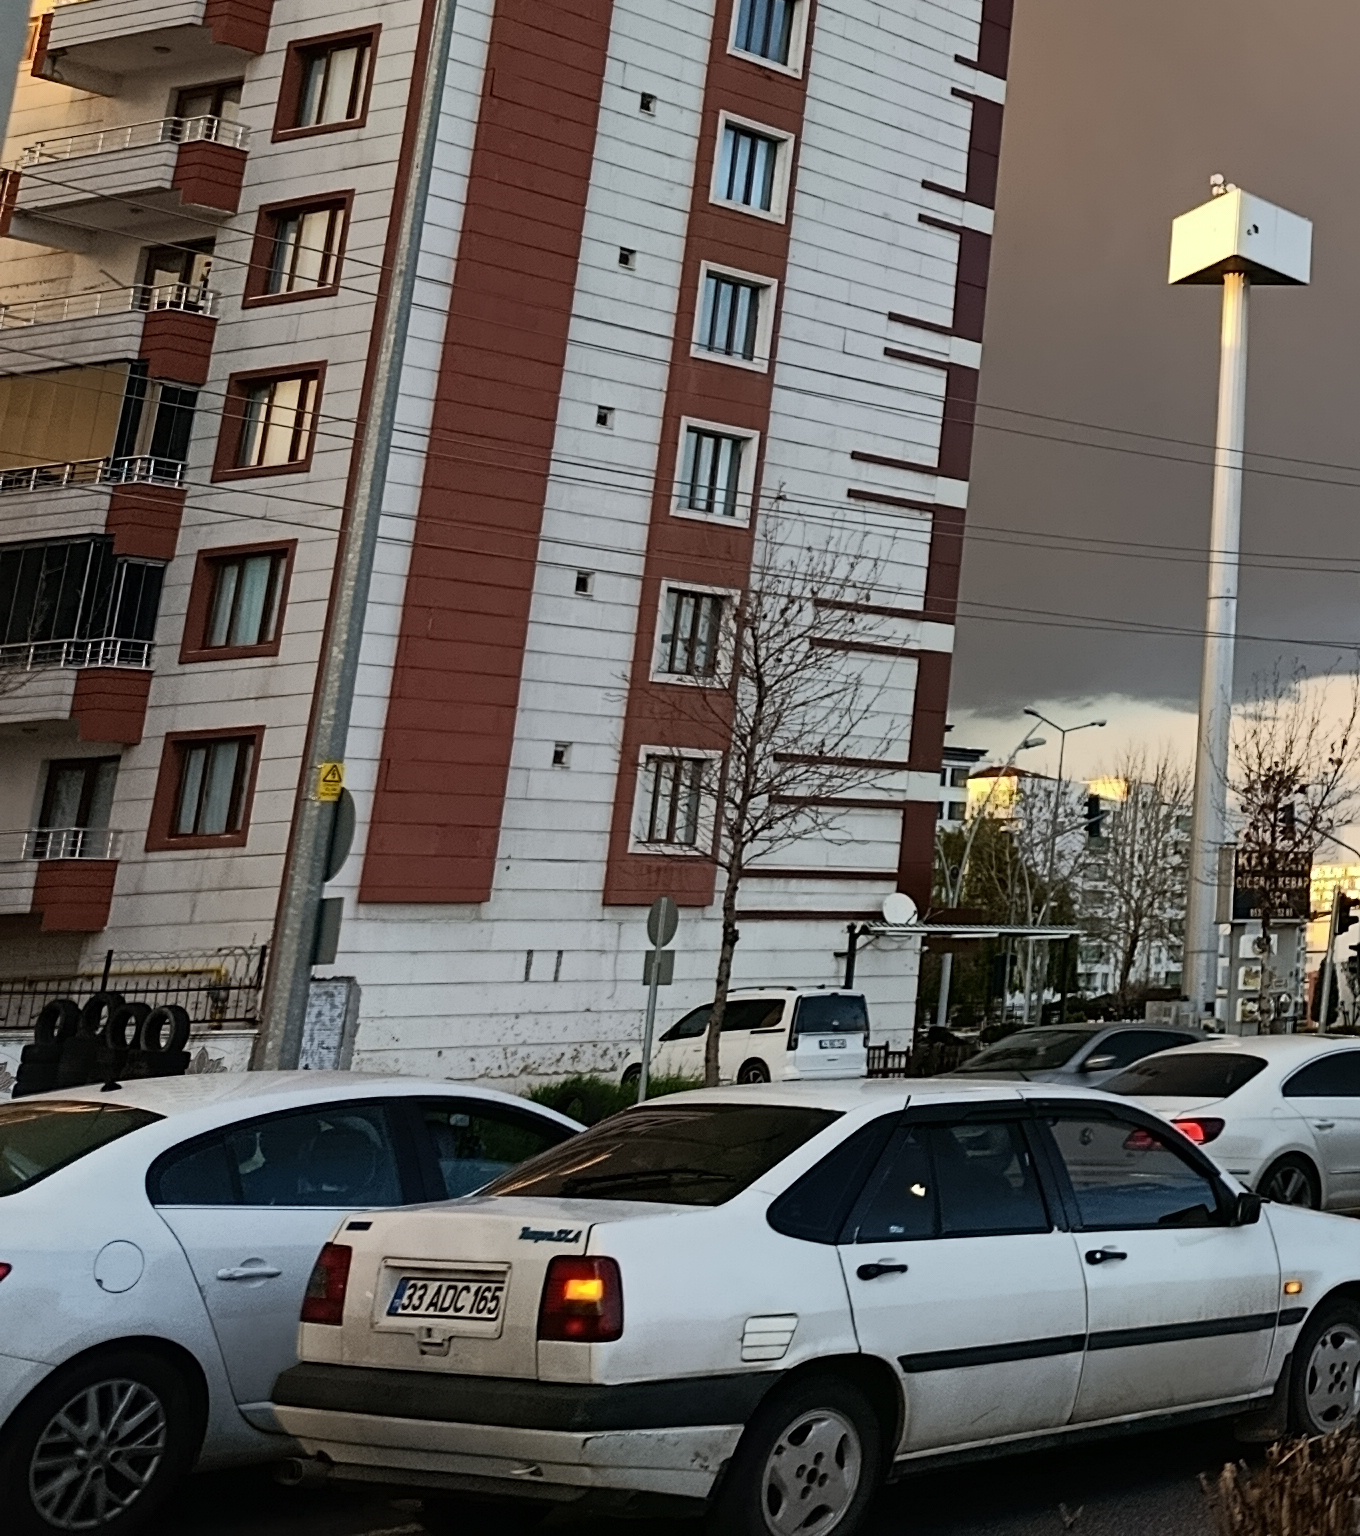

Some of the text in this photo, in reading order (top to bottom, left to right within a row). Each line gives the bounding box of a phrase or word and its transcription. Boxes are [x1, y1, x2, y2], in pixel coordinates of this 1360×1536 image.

[402, 1282, 504, 1315] 33 ADC 165
